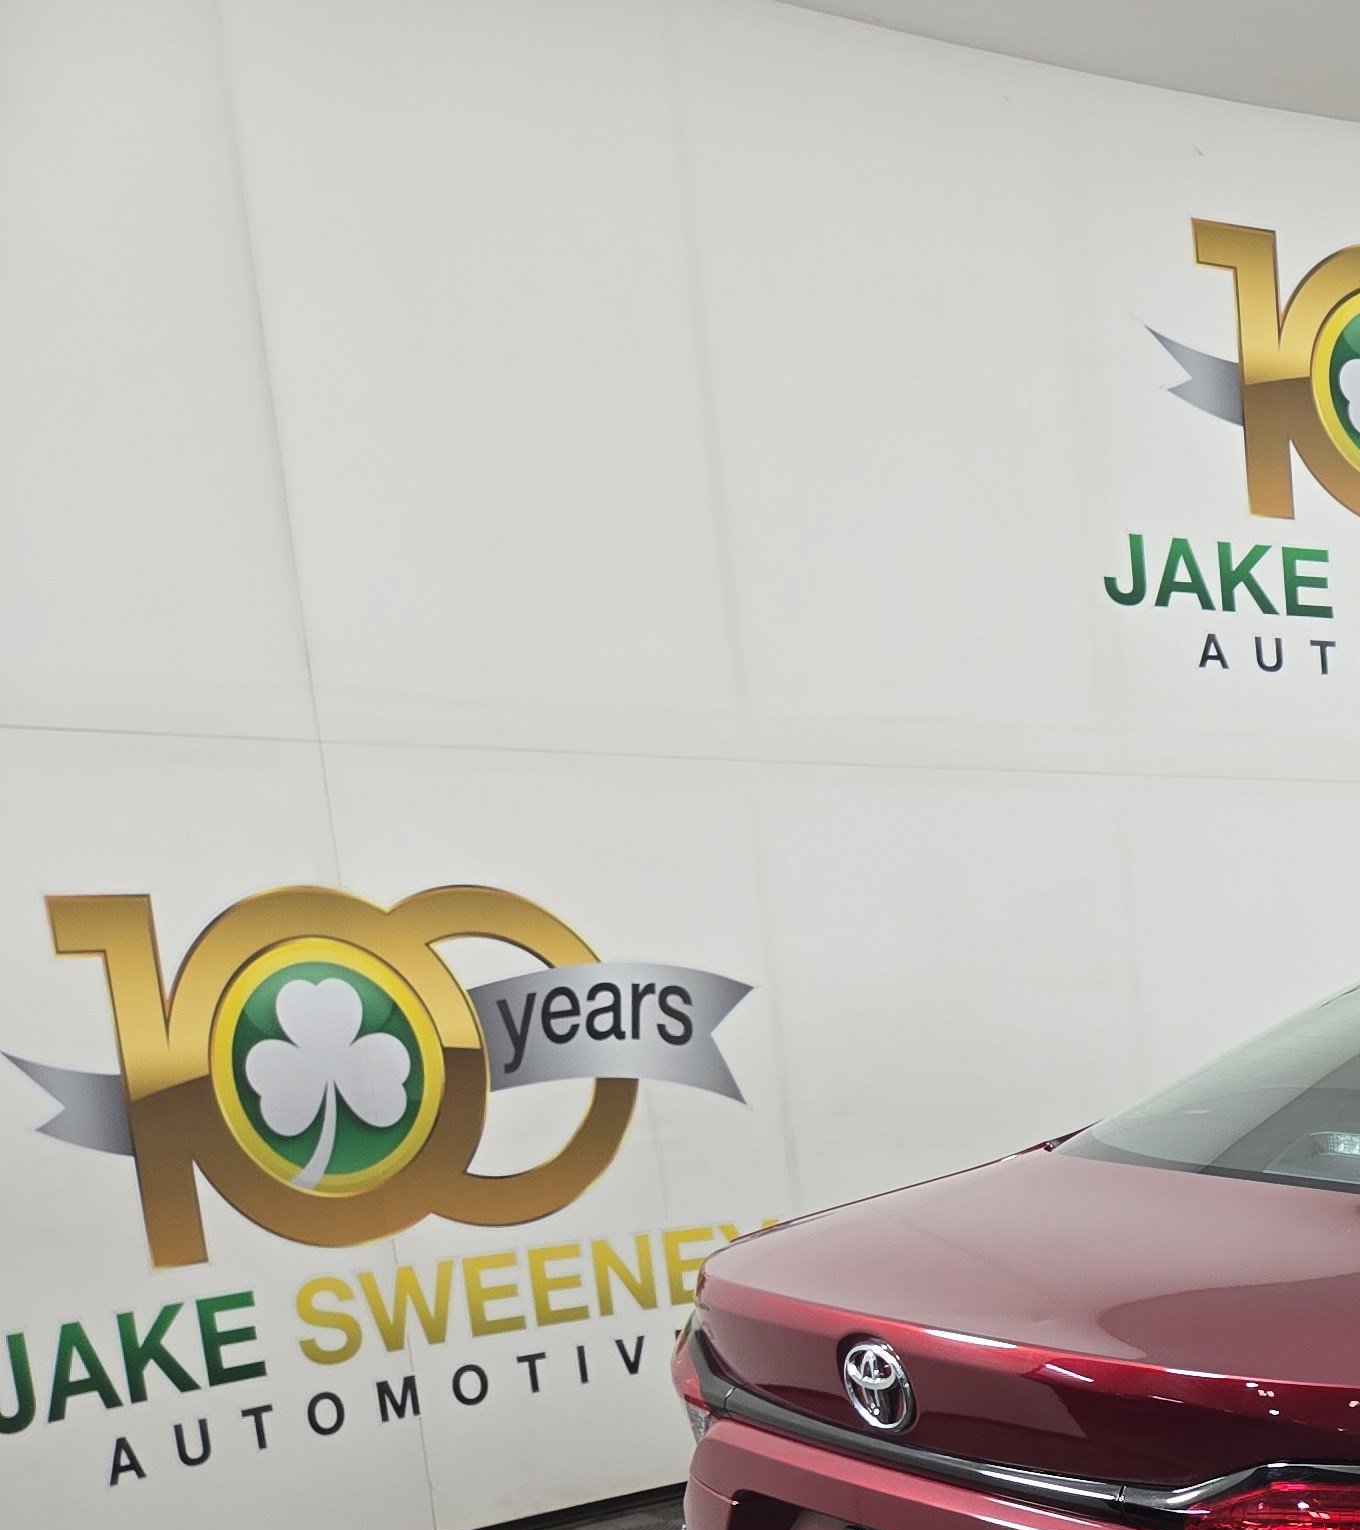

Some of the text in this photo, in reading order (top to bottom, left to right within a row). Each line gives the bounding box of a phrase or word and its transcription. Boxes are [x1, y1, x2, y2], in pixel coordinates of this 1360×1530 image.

[1103, 534, 1334, 618] JAKE
[495, 981, 694, 1073] years
[0, 1218, 779, 1434] JAKE SWEENE
[109, 1329, 681, 1487] AUTOMOTIV
